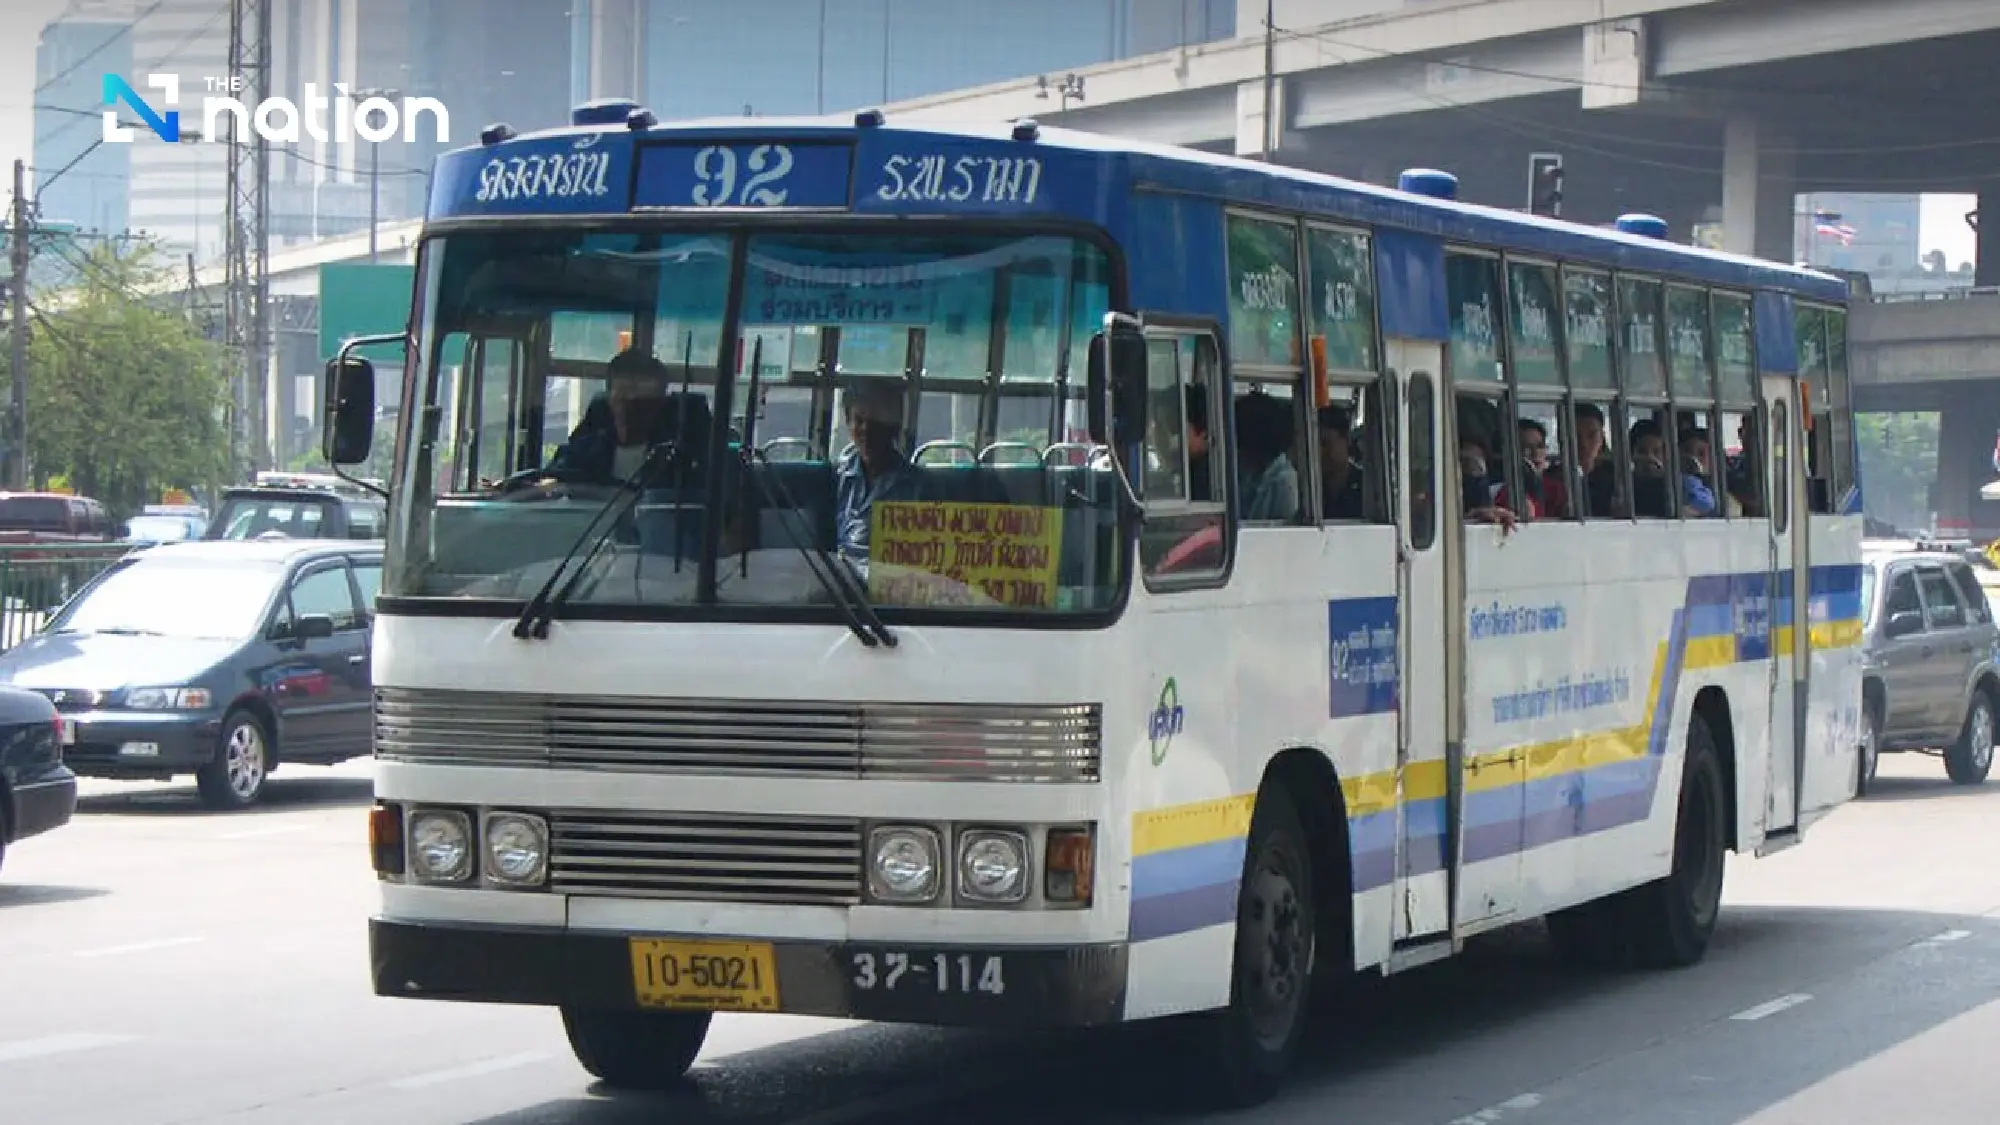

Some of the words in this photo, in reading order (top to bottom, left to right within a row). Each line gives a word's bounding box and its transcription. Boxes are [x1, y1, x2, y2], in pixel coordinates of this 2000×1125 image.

[692, 144, 795, 207] 92
[1332, 640, 1348, 680] 92
[645, 953, 761, 991] 10-5021
[853, 952, 1005, 994] 37-114
